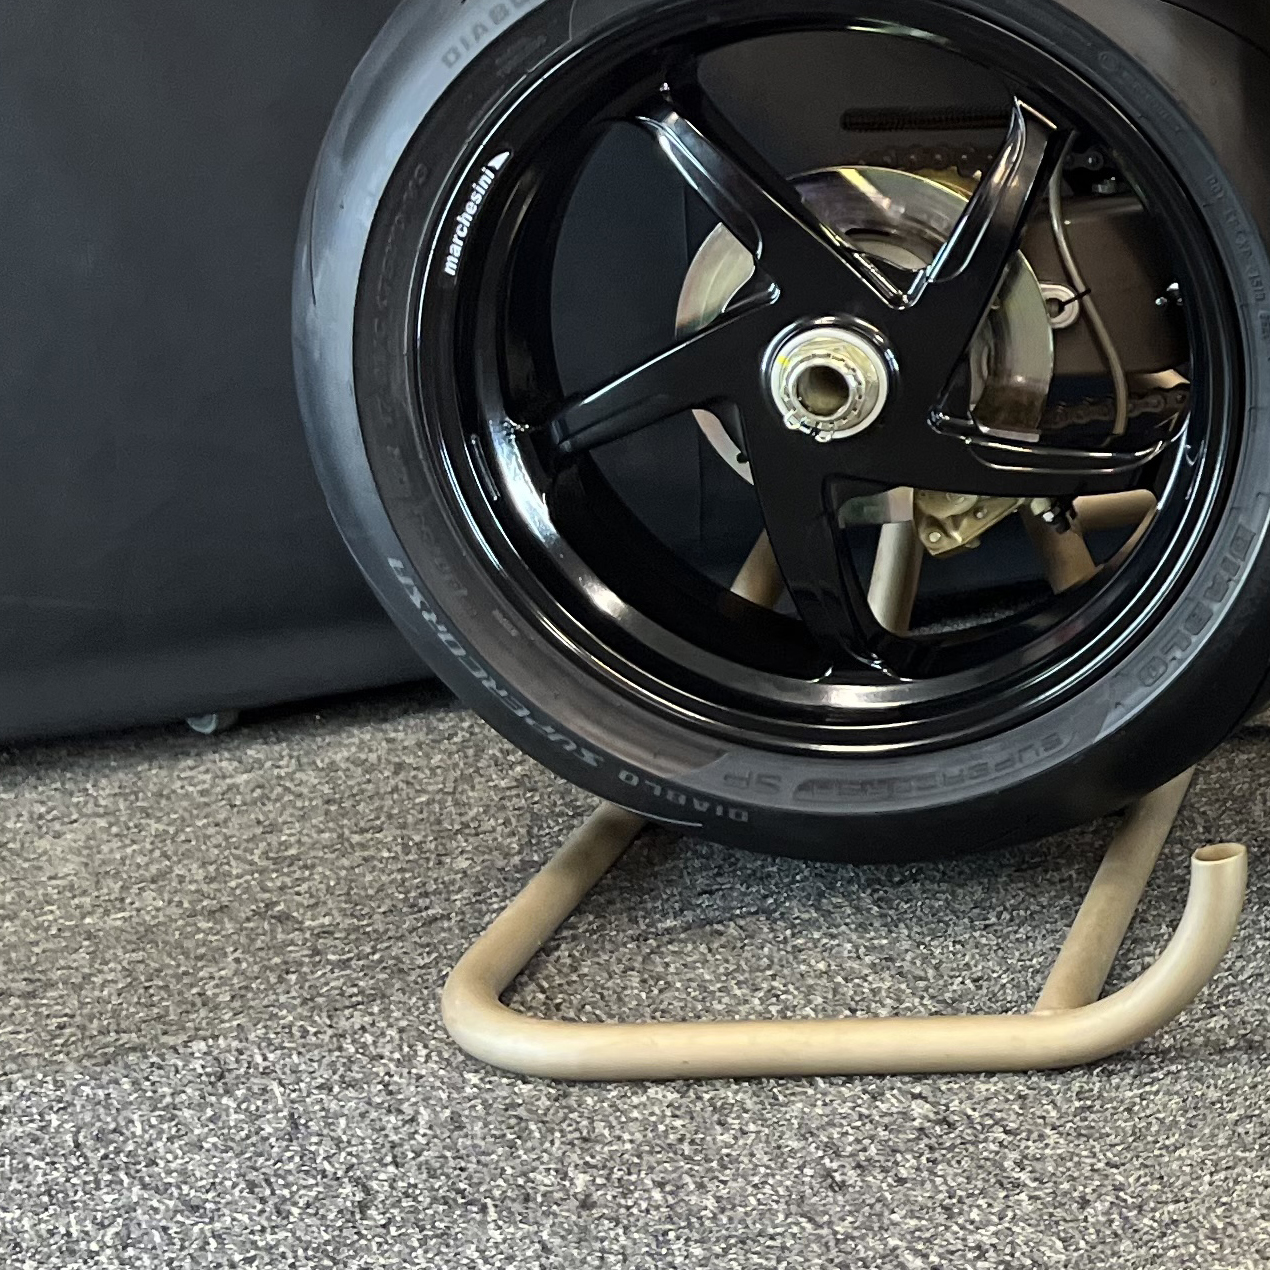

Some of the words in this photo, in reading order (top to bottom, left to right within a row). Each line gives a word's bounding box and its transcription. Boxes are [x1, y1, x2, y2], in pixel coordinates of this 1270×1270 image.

[444, 166, 495, 276] marchesini
[387, 555, 605, 771] SUPERCORSA
[617, 767, 750, 824] DIABLO
